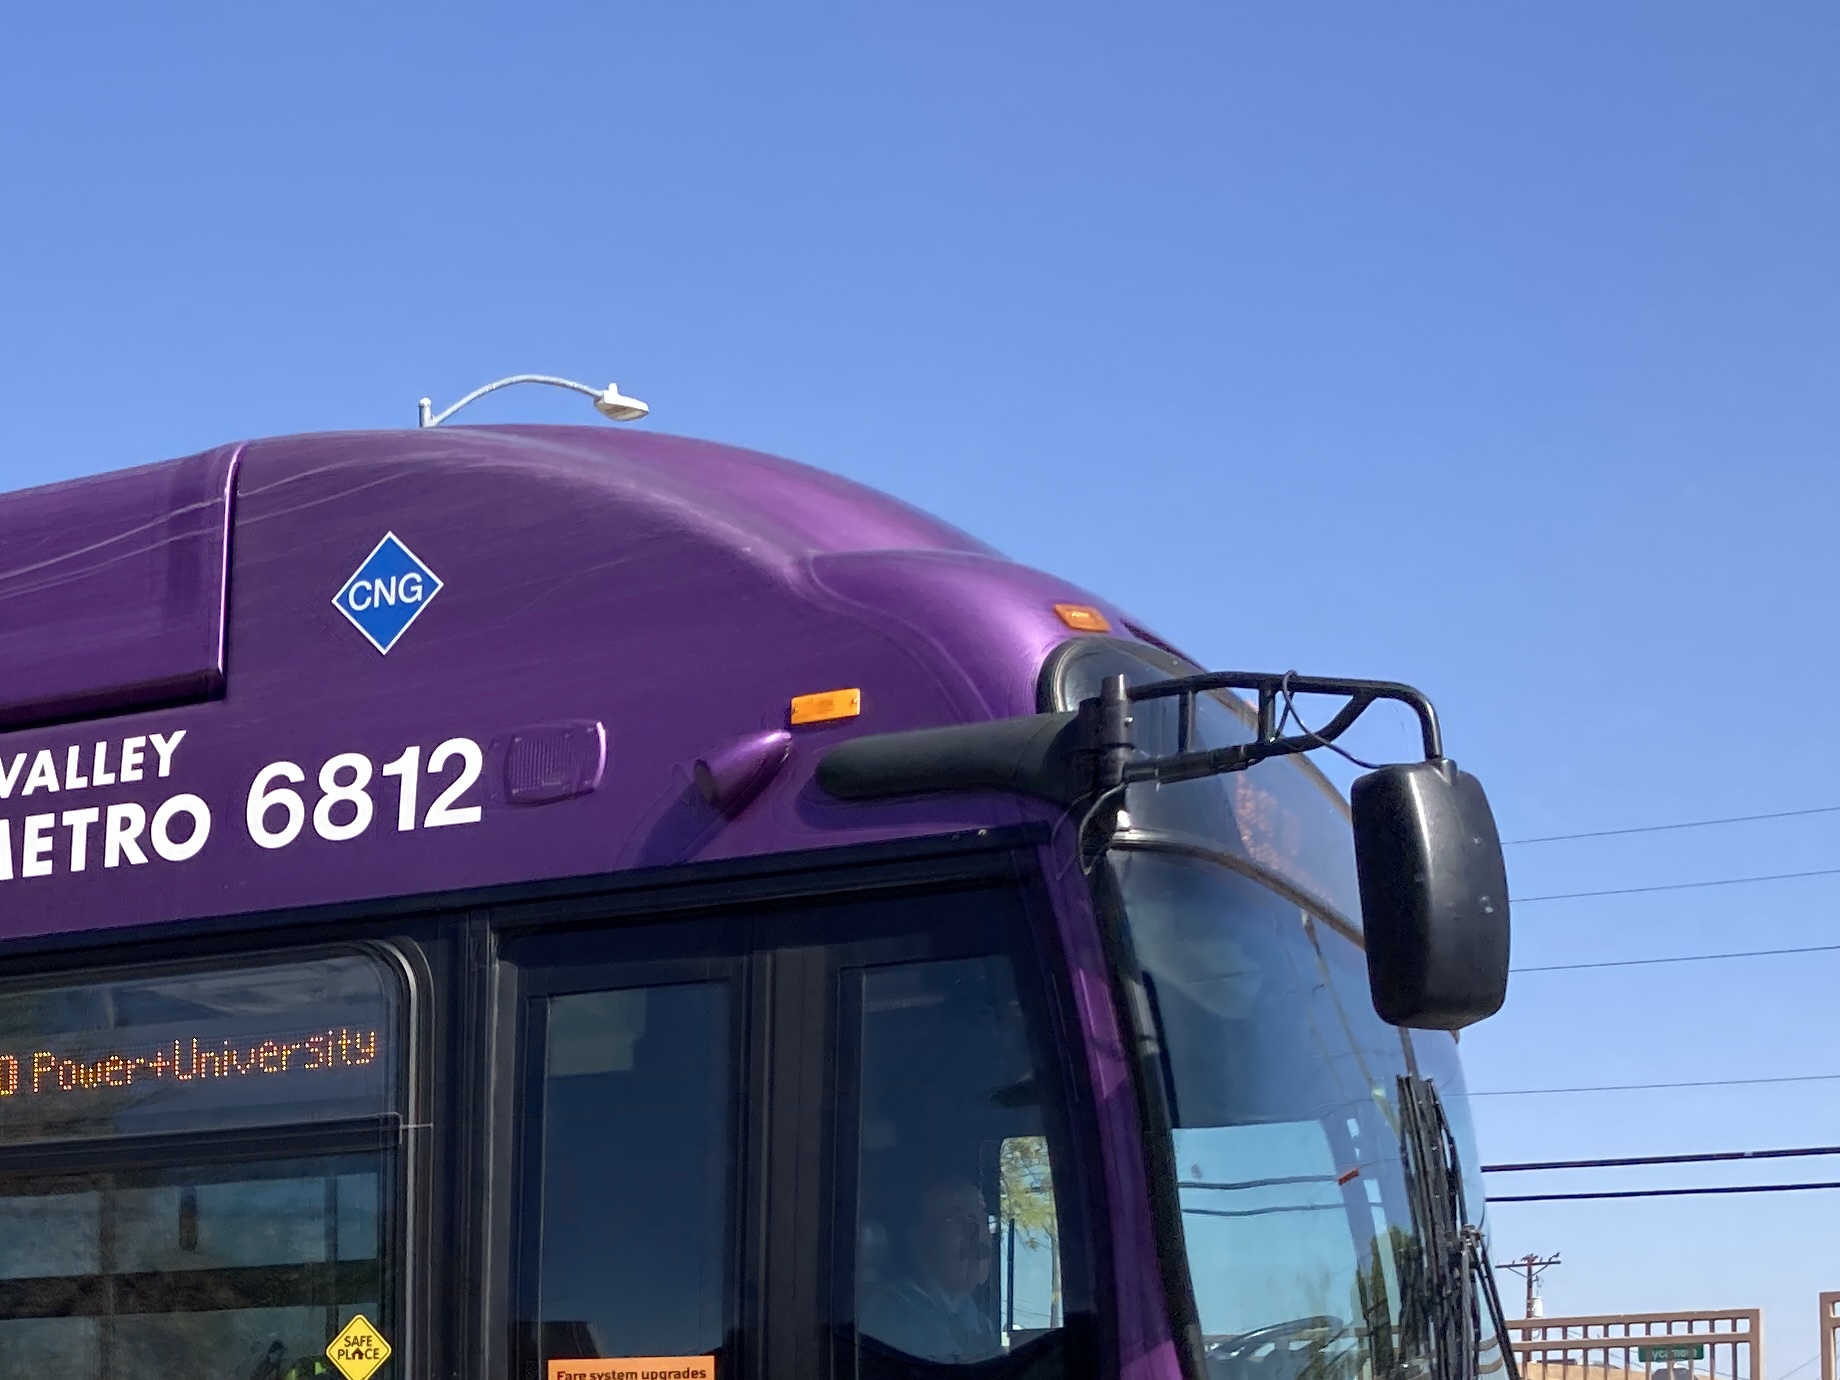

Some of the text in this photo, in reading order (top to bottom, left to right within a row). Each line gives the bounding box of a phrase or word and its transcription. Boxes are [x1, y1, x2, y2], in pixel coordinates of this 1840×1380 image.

[348, 572, 423, 611] CNG
[246, 737, 483, 849] 6812
[344, 1335, 372, 1347] SAFE
